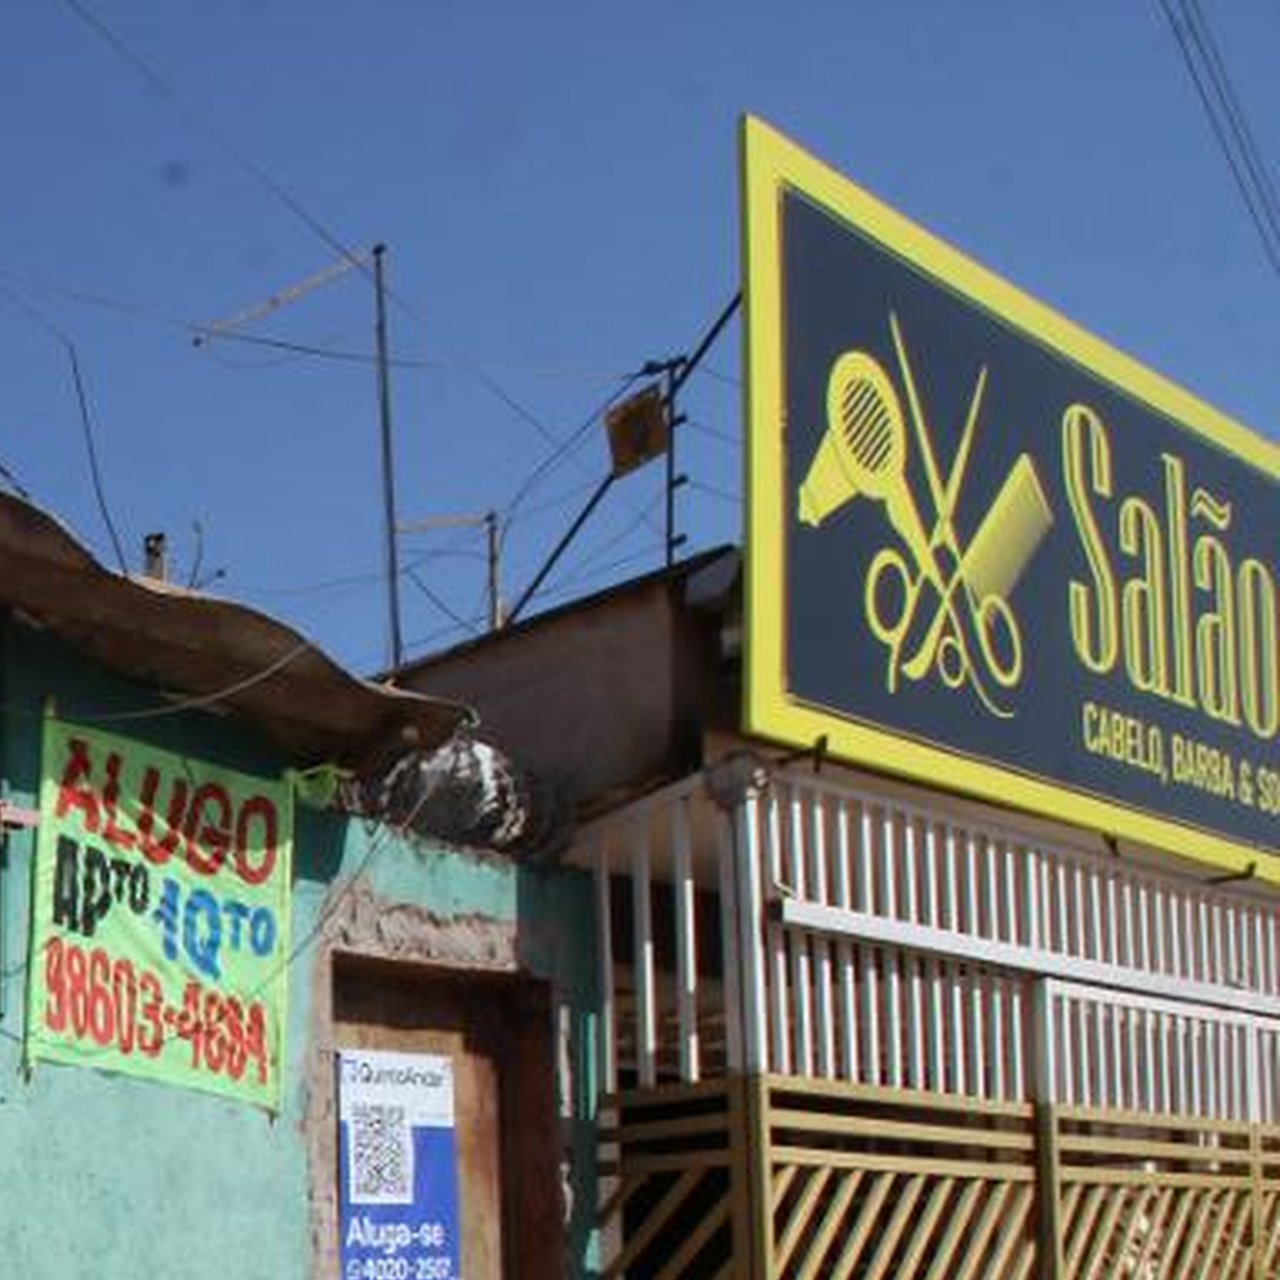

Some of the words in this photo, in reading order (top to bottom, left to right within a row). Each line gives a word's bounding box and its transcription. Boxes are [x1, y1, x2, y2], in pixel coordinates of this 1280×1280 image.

[1063, 403, 1279, 740] Salão
[1083, 702, 1168, 786] CABELO,
[1172, 733, 1234, 799] BARBA
[56, 737, 278, 885] ALUGO
[53, 836, 150, 937] APTO
[345, 1216, 445, 1254] Aluga-se
